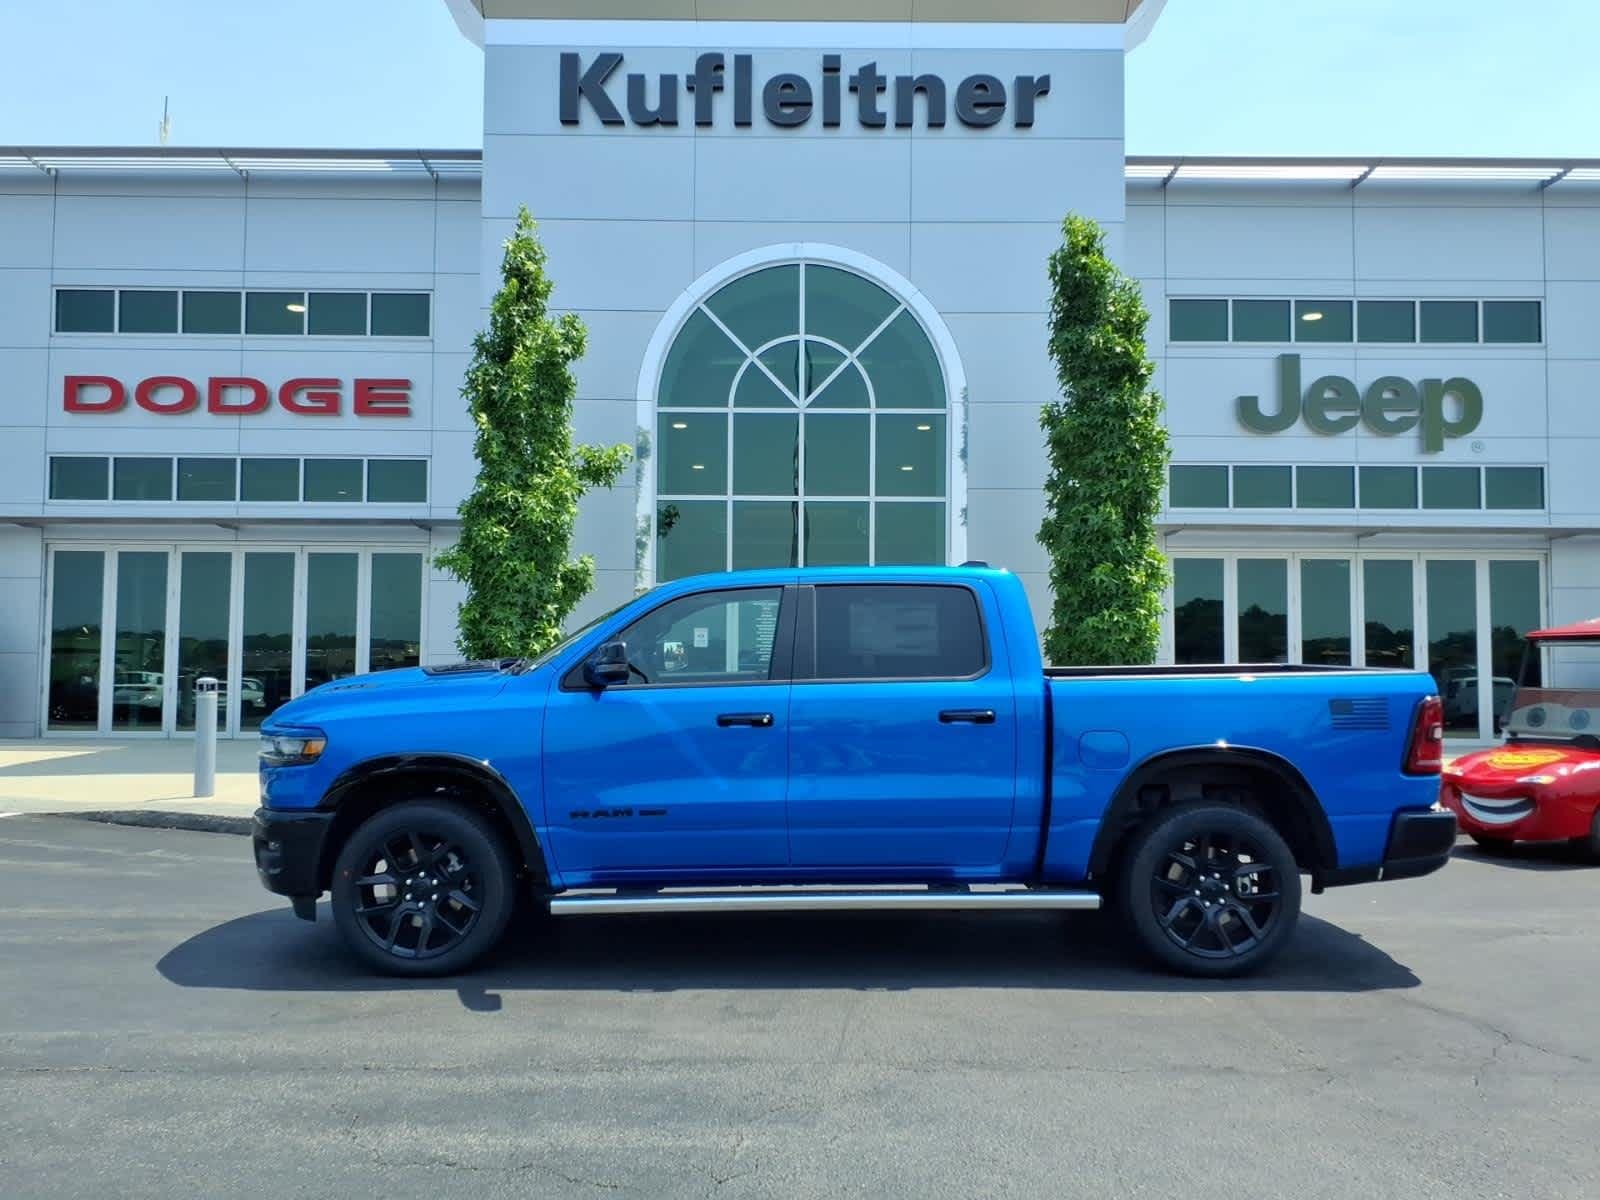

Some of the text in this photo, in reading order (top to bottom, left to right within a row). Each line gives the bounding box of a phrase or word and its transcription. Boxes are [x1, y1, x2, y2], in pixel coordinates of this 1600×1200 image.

[559, 52, 1051, 128] Kufleitner
[63, 375, 412, 416] DODGE
[1236, 353, 1484, 453] Jeep
